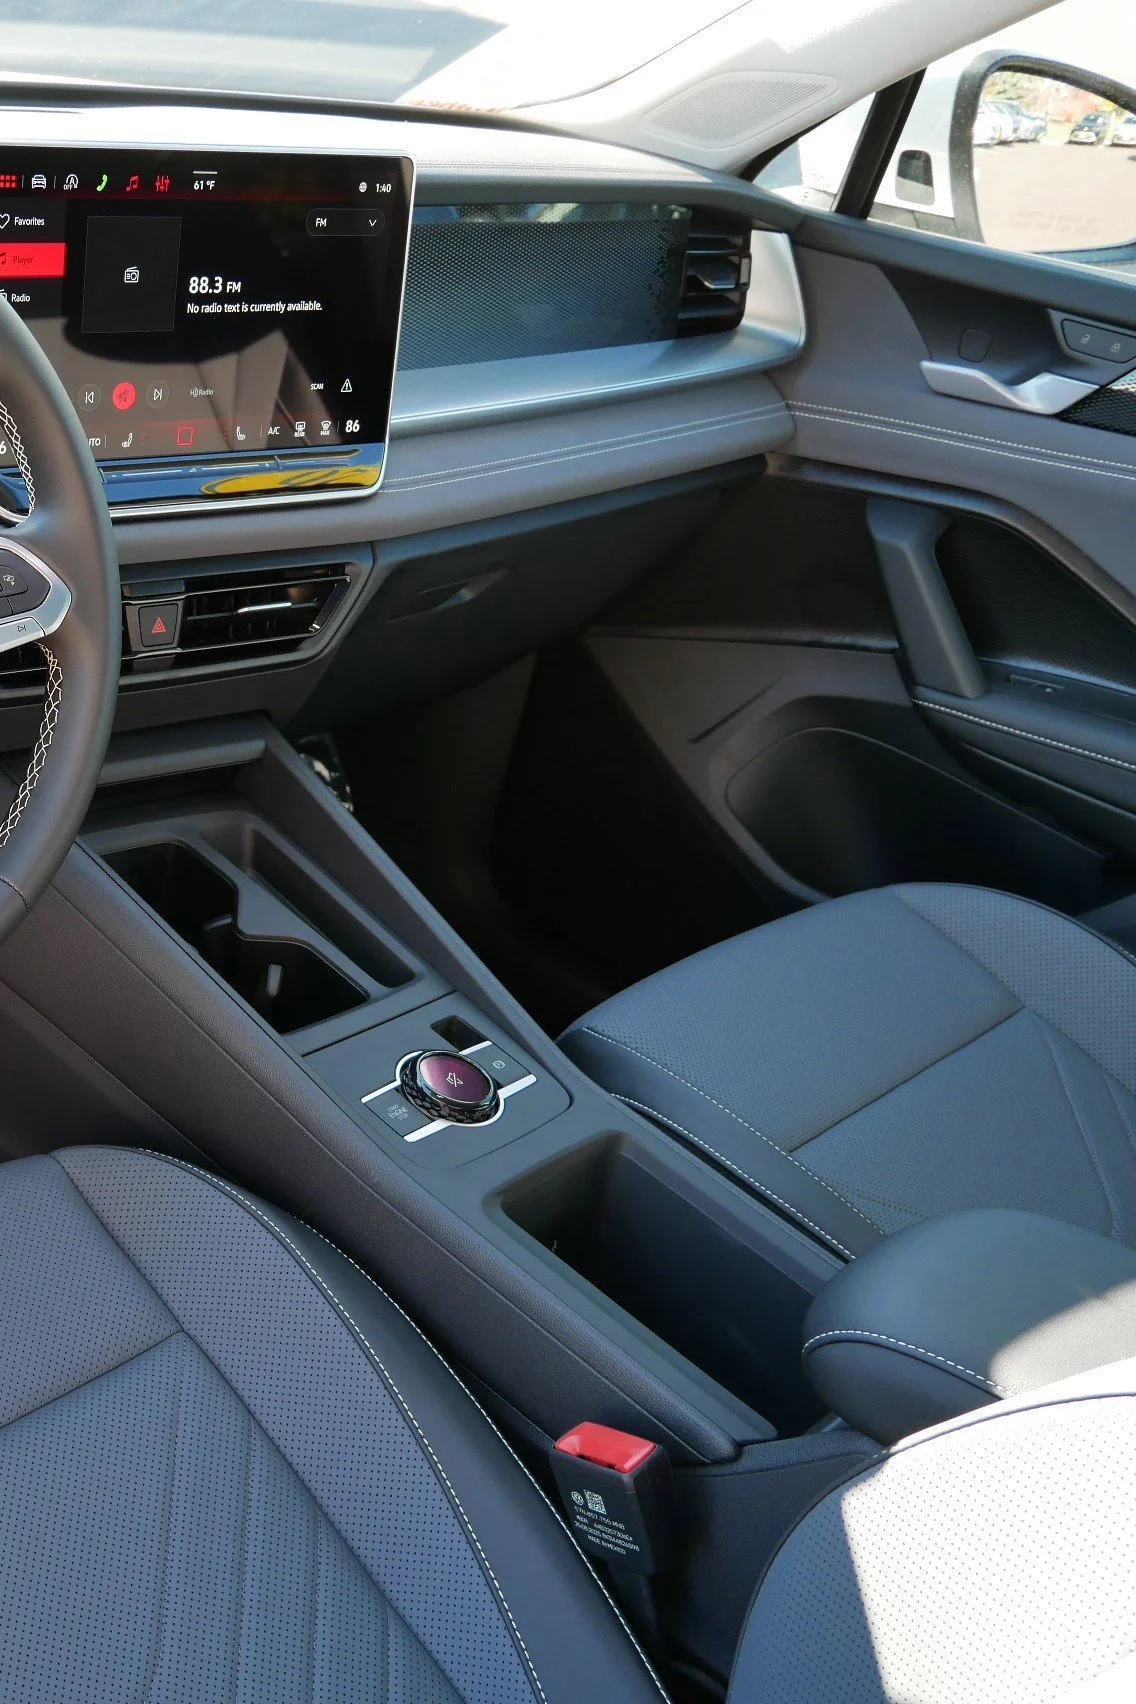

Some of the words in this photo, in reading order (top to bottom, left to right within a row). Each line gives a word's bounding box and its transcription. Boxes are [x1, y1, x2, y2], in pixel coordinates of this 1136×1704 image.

[193, 180, 204, 190] 61
[375, 183, 392, 193] 1:40
[14, 216, 45, 226] Favorites
[315, 217, 327, 227] FM
[13, 255, 34, 265] Player
[188, 276, 223, 294] 88.3
[226, 281, 242, 293] FM
[11, 293, 31, 302] Radio
[187, 303, 200, 313] No
[201, 302, 222, 313] radio
[224, 303, 240, 312] text
[241, 301, 249, 312] is
[250, 301, 285, 313] currently
[286, 301, 323, 311] available.
[310, 383, 324, 391] SCAN
[268, 427, 280, 435] A/C
[345, 420, 360, 433] 86
